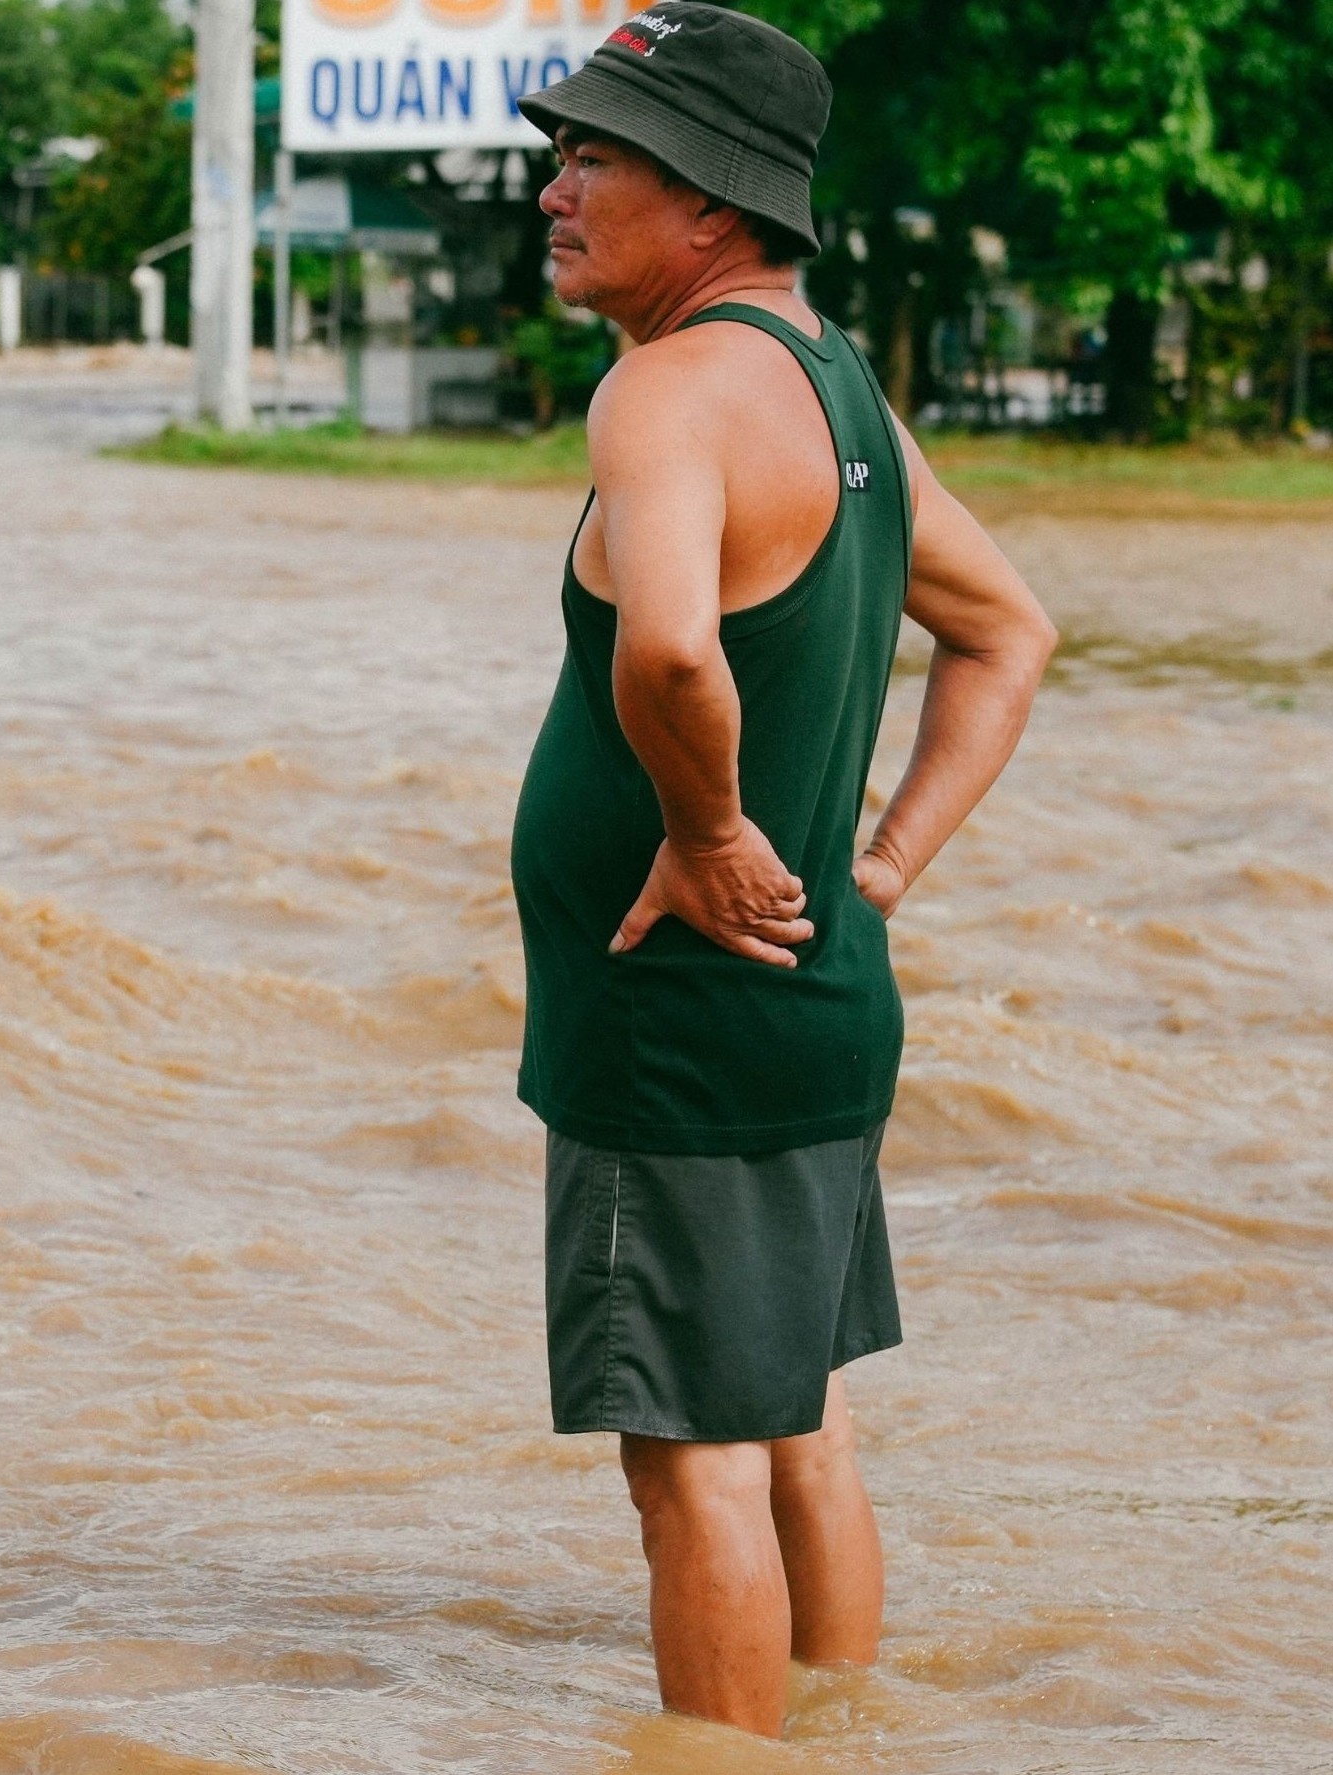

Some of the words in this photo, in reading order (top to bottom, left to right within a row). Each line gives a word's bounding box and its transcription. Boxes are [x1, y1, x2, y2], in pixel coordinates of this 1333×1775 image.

[311, 41, 472, 130] QUÁN
[501, 41, 588, 120] VÔ
[845, 461, 869, 488] GAP
